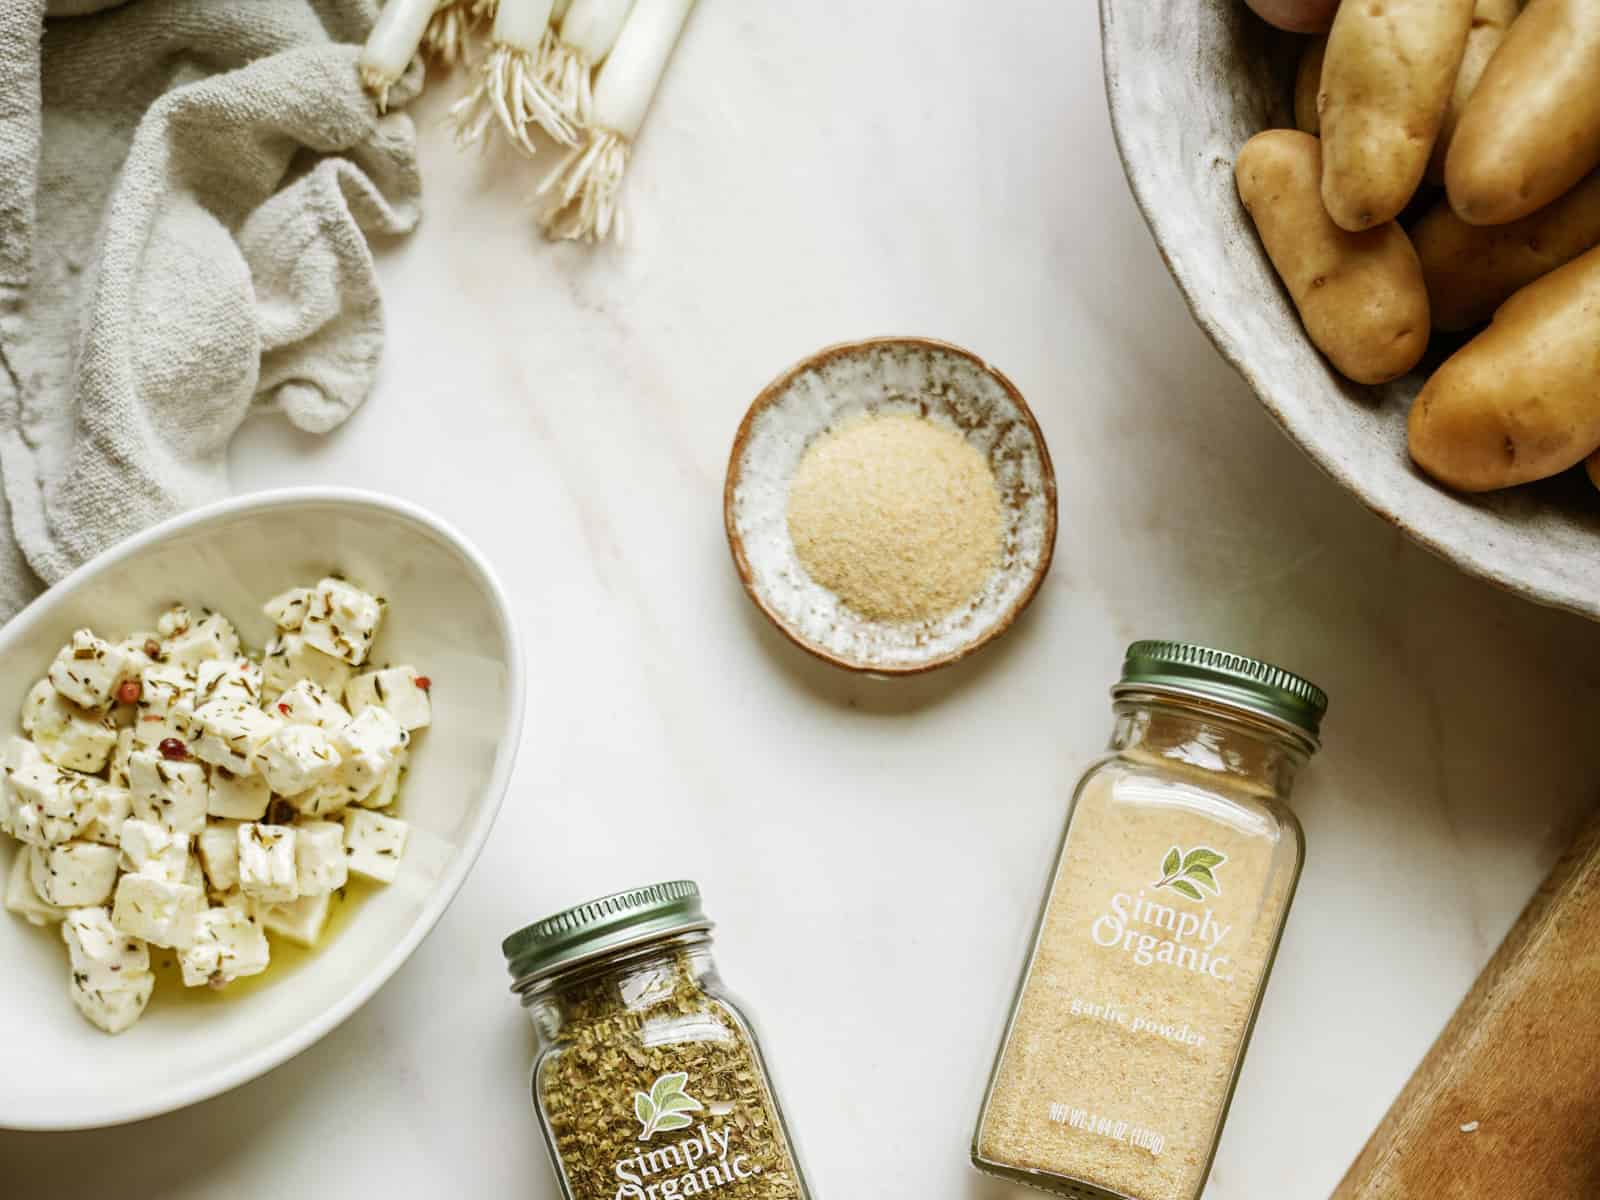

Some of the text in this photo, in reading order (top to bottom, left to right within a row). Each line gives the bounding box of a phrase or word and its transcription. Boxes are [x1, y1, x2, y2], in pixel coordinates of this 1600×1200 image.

[1111, 890, 1231, 947] Simply
[1129, 1014, 1206, 1046] powder
[615, 1123, 731, 1187] Simply
